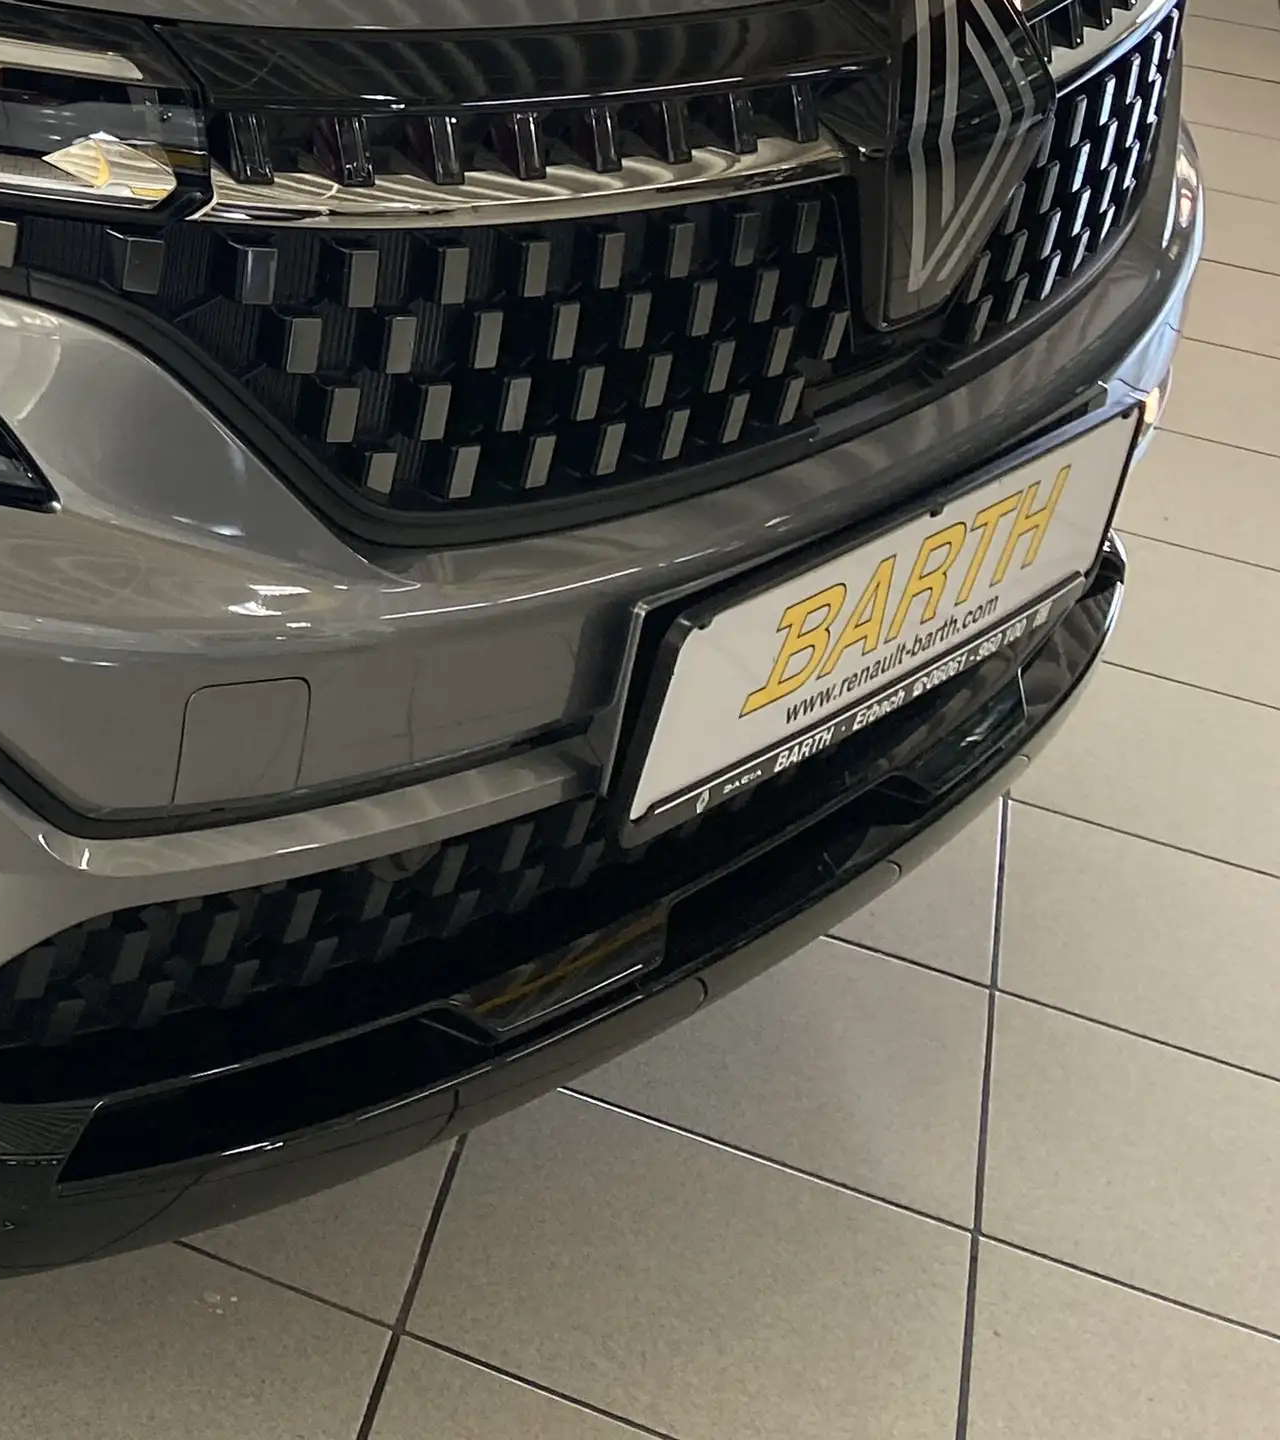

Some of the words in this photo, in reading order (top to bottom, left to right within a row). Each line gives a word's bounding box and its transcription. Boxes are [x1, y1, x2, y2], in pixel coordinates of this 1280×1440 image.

[738, 463, 1072, 719] BARTH
[784, 594, 1000, 725] www.renault-barth.com
[773, 725, 835, 774] BARTH
[852, 690, 906, 731] Erbach
